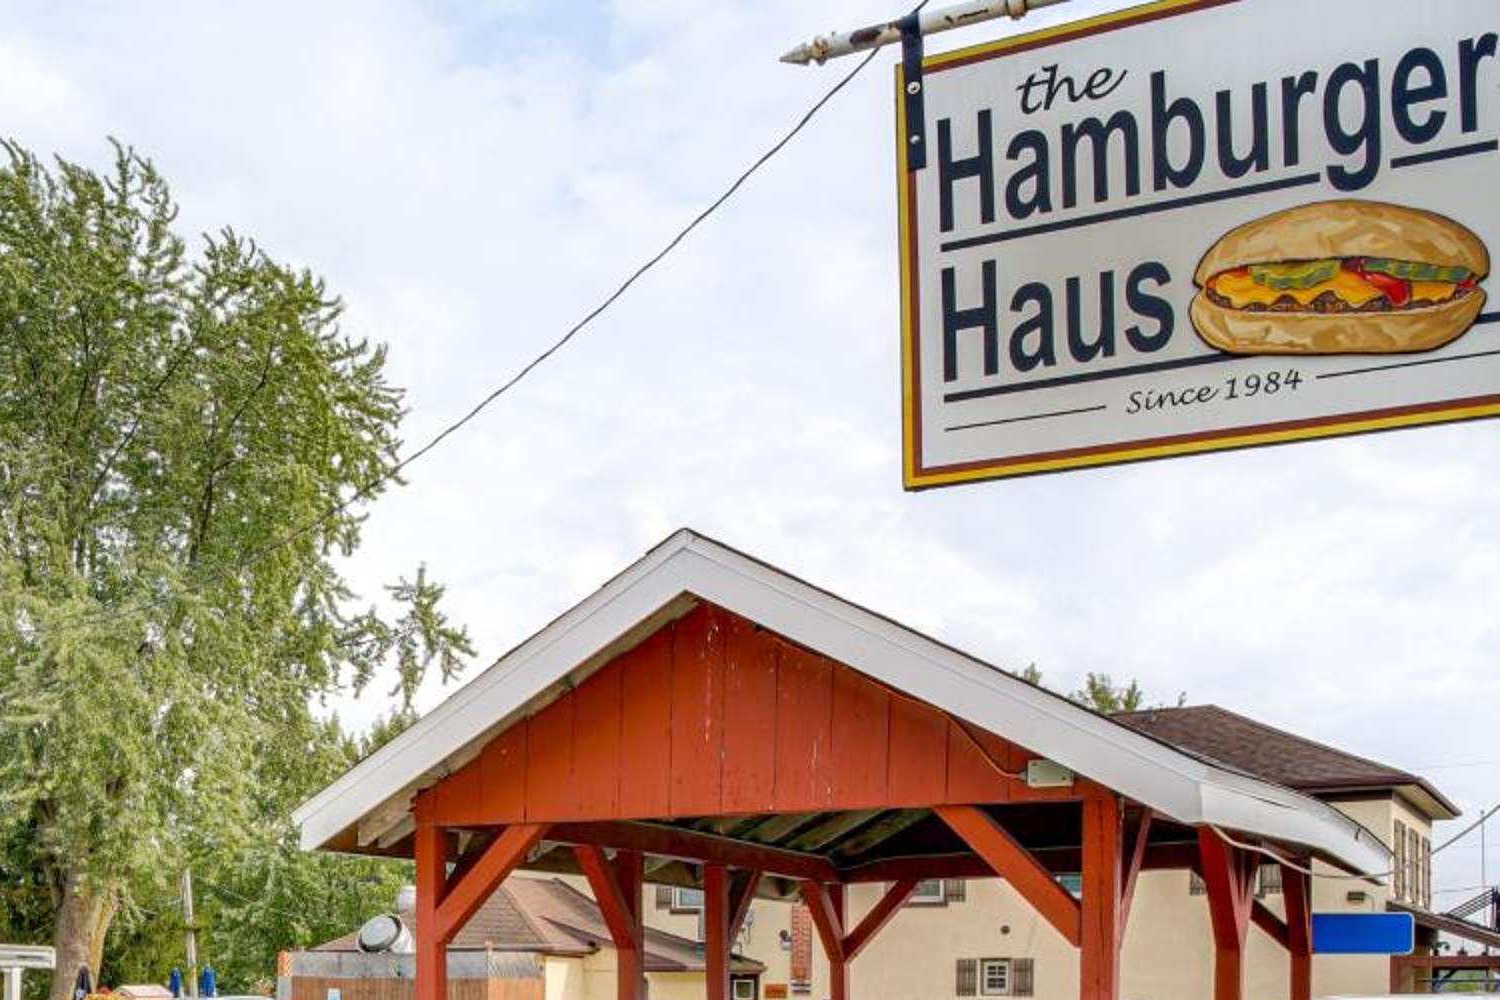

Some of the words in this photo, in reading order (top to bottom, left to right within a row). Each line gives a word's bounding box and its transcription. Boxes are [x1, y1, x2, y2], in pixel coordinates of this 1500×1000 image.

[936, 31, 1500, 233] Hamburger
[1015, 63, 1128, 115] the
[941, 259, 1175, 383] Haus
[1125, 383, 1219, 415] Since
[1225, 368, 1303, 401] 1984
